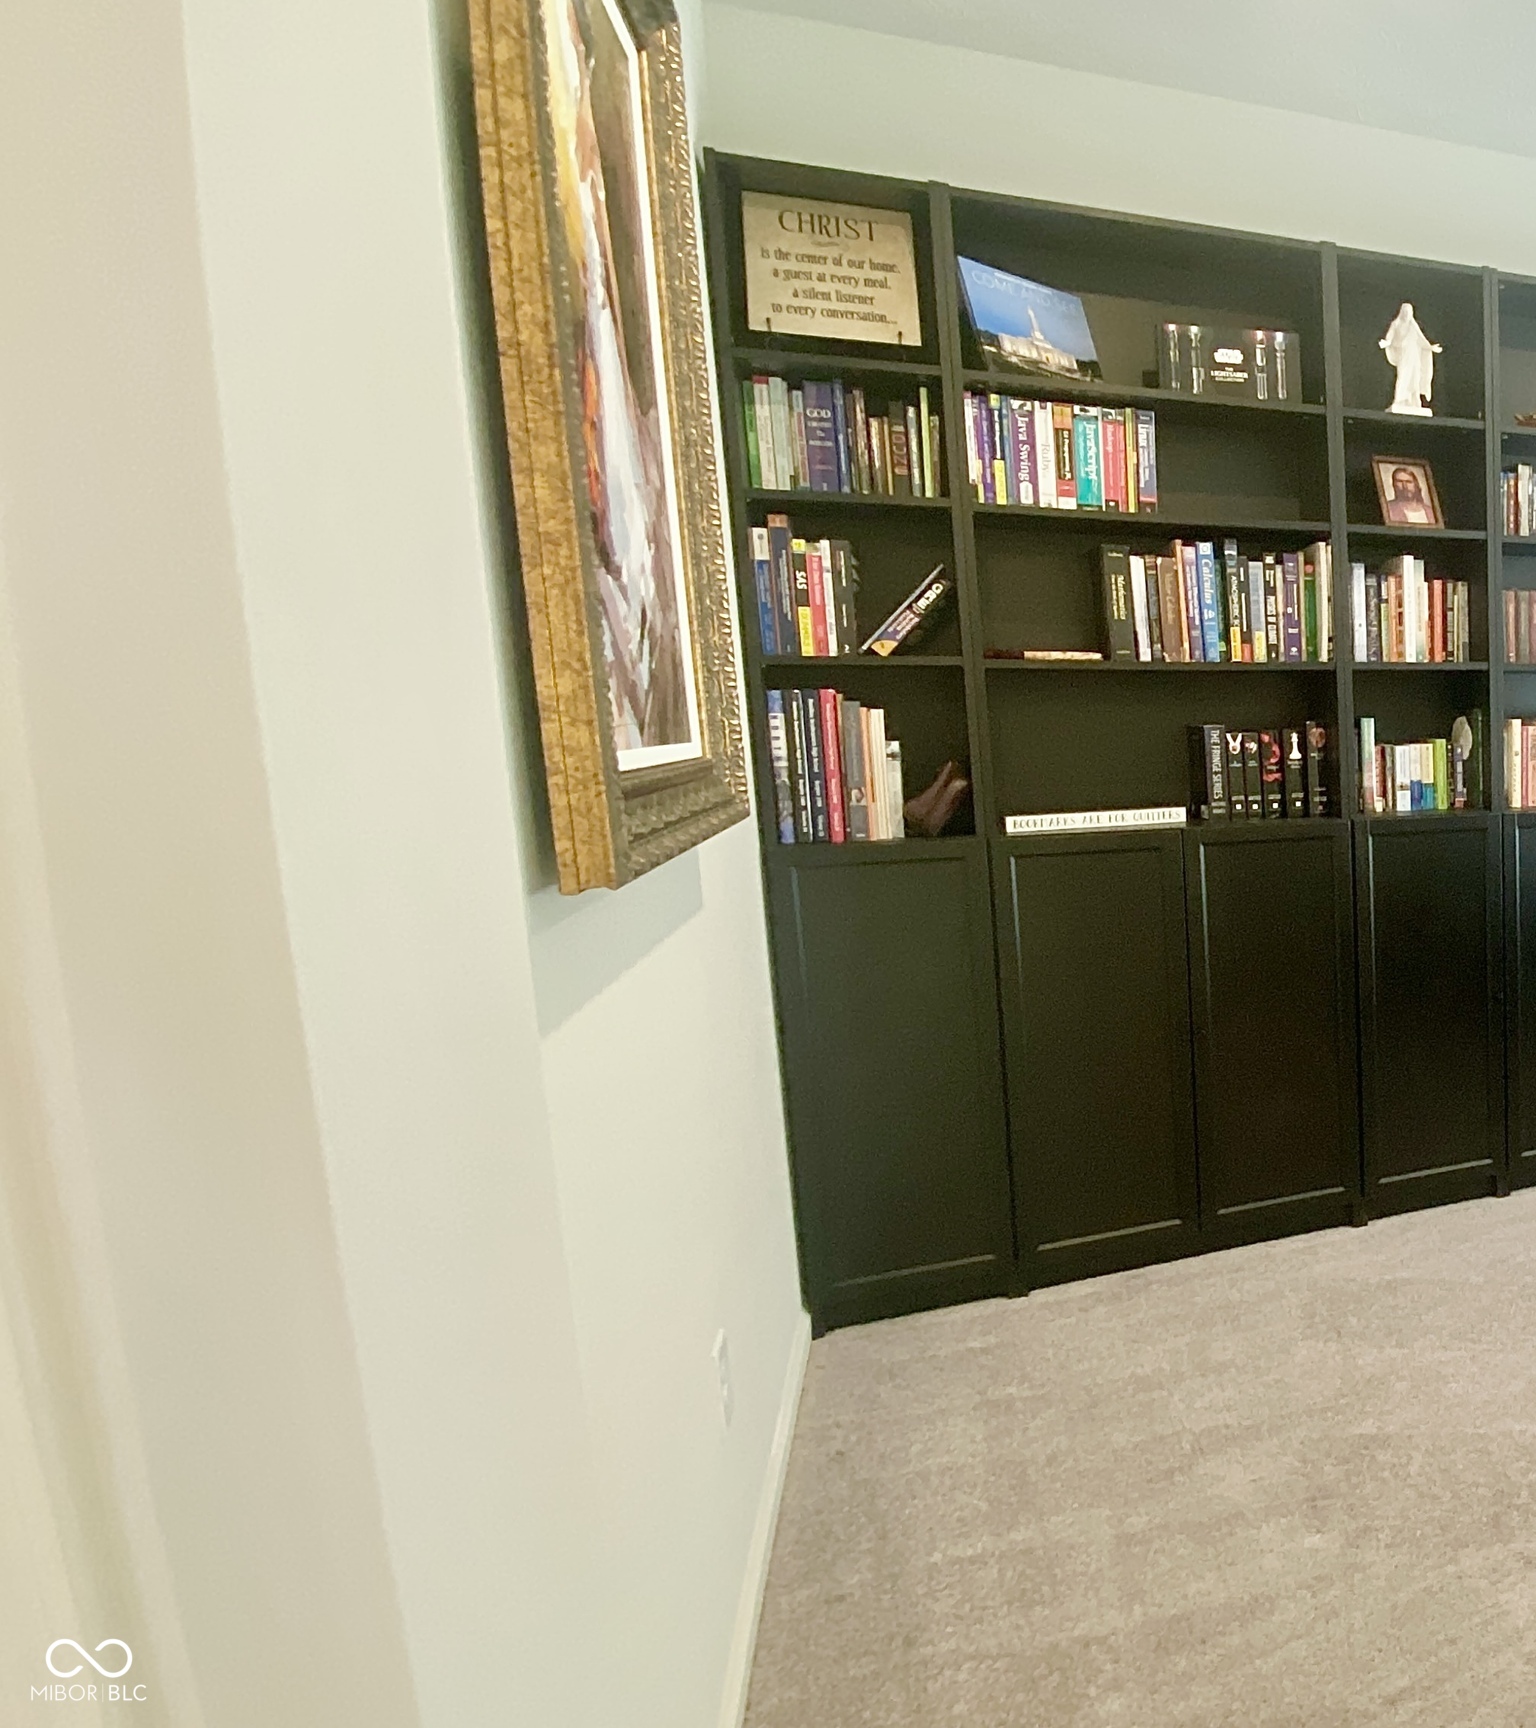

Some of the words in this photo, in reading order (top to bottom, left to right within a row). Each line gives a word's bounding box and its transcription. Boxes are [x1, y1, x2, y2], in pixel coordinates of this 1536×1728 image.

[778, 209, 879, 242] CHRIST
[760, 246, 770, 259] is
[774, 247, 791, 261] the
[795, 251, 829, 266] center
[832, 253, 843, 266] of
[847, 258, 866, 270] our
[773, 267, 779, 278] a
[782, 268, 814, 282] guest
[816, 270, 826, 282] at
[830, 274, 860, 289] every
[792, 287, 799, 298] a
[802, 287, 833, 302] silent
[836, 289, 875, 306] listener
[771, 302, 783, 314] to
[786, 303, 817, 319] every
[806, 408, 831, 419] GOD
[1015, 412, 1029, 441] Java
[1040, 443, 1052, 474] Ruby
[1084, 421, 1098, 481] JavaScript
[1018, 445, 1032, 485] Swing
[795, 570, 807, 590] SAS
[1201, 558, 1215, 605] Calculus
[916, 583, 944, 610] GRE
[1210, 729, 1220, 744] THE
[1211, 745, 1222, 772] FRINGE
[1213, 773, 1223, 799] SERIES
[1013, 816, 1076, 830] BOOKMARKS
[1082, 814, 1101, 825] ARE
[1108, 812, 1127, 824] FOR
[1132, 811, 1181, 822] QUITTERS
